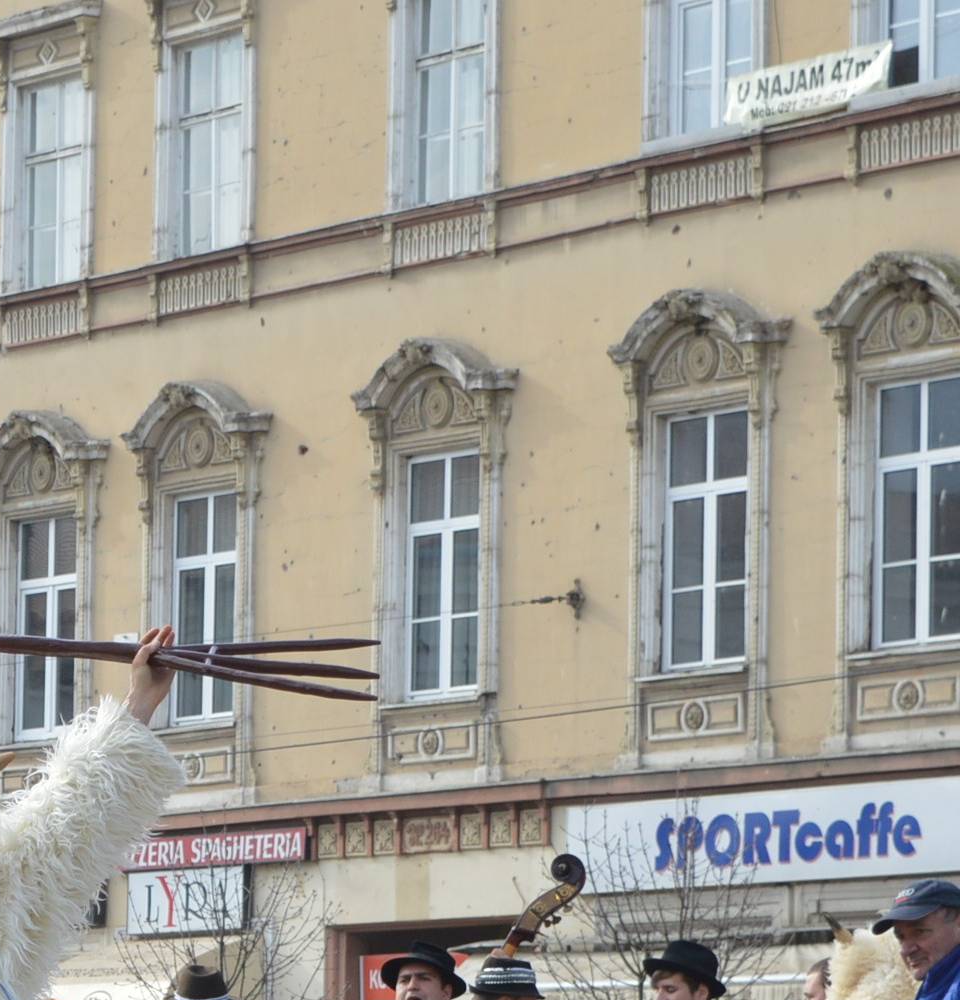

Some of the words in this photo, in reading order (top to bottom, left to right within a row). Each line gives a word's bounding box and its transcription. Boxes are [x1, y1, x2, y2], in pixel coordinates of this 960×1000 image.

[756, 64, 824, 101] NAJAM
[190, 831, 303, 864] SPAGHETERIA
[654, 800, 922, 874] SPORTcaffe
[144, 873, 234, 928] LYRA
